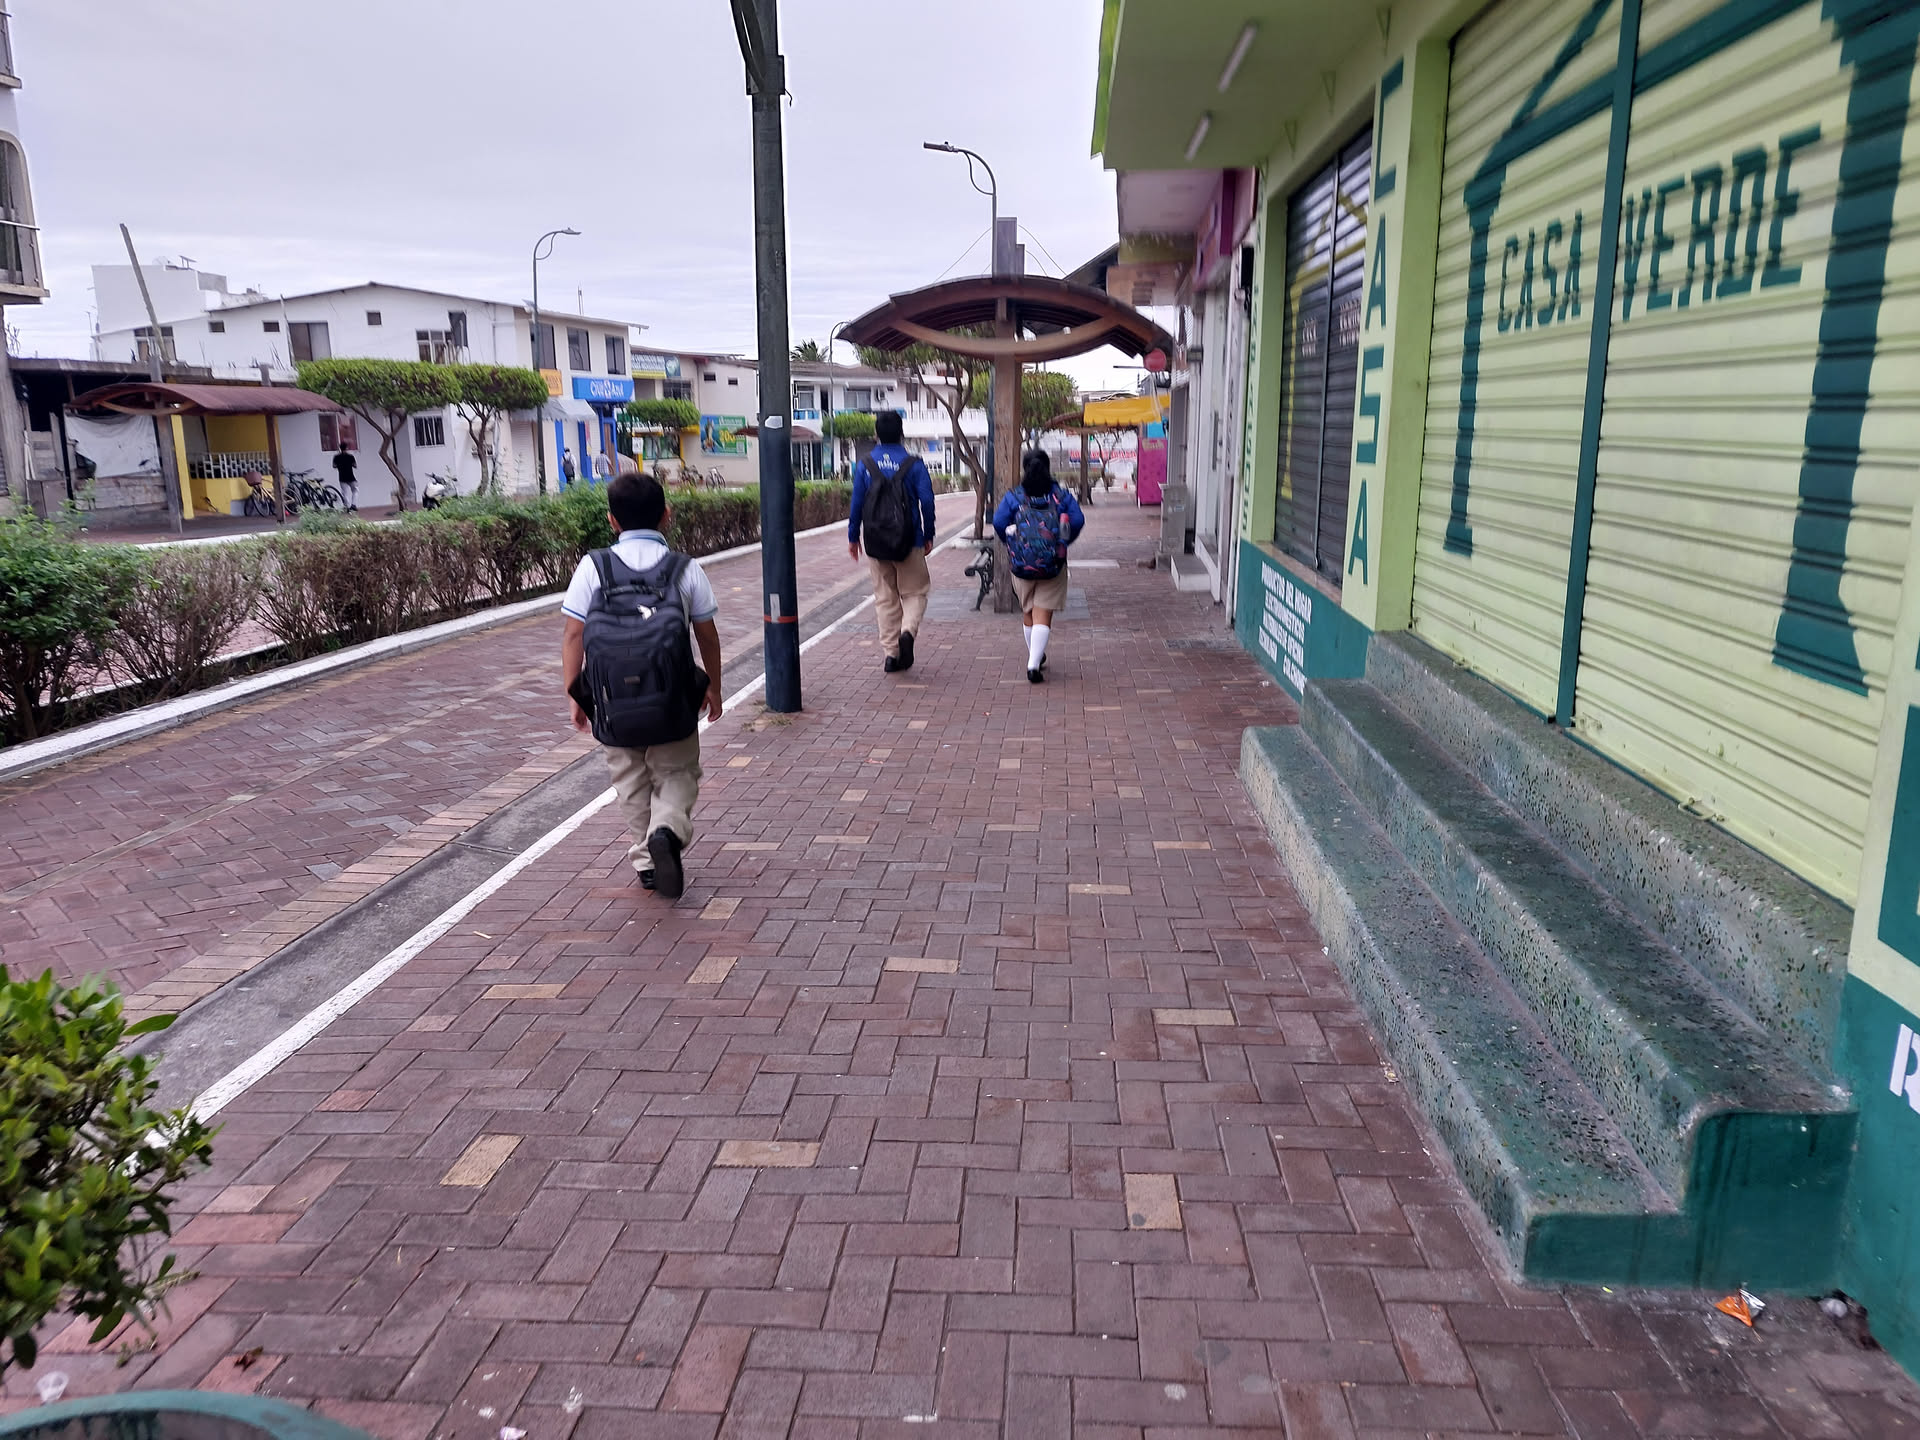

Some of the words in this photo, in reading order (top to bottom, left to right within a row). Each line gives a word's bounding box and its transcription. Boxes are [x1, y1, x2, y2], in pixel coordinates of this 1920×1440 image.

[1348, 60, 1404, 586] CASA
[1498, 209, 1582, 333] CASA
[1622, 122, 1821, 322] VERDE
